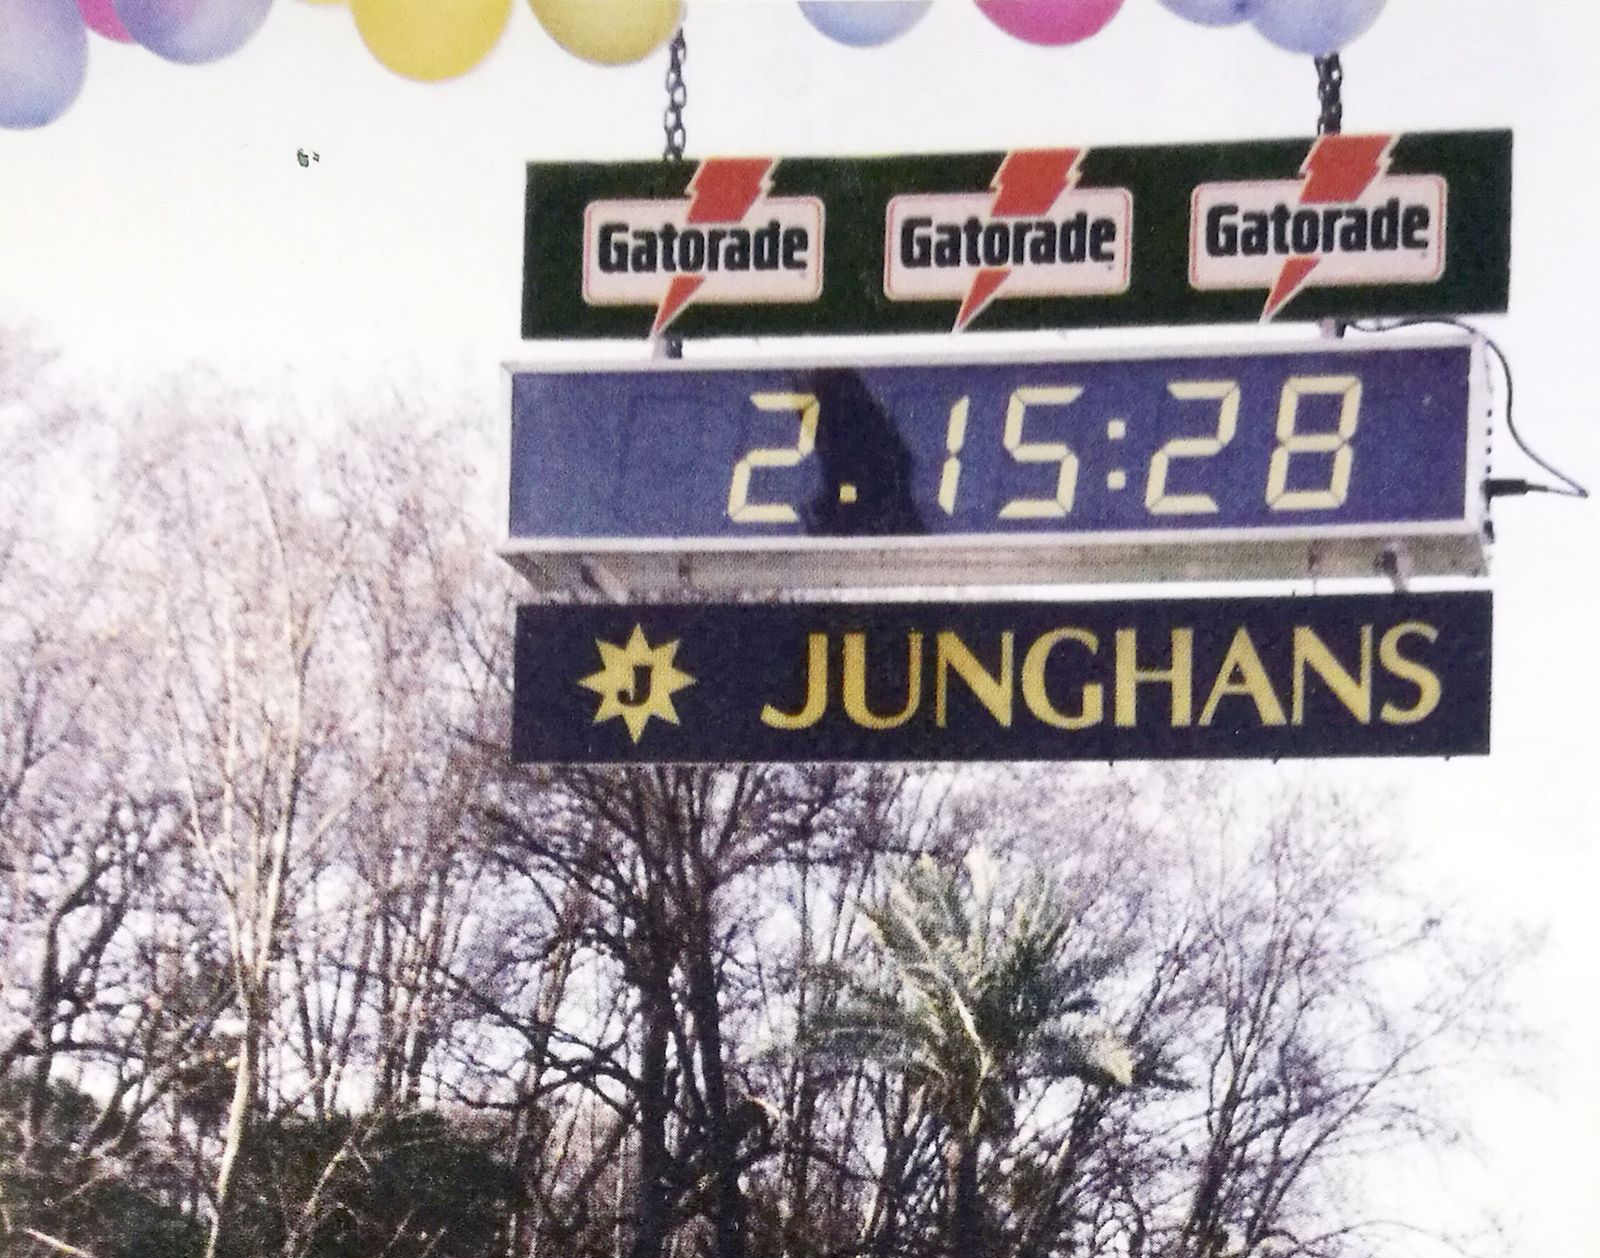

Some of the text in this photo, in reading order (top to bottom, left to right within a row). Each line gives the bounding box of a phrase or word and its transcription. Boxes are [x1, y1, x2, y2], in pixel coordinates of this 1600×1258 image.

[597, 199, 1431, 277] Gatorade Gatorade Gatorade
[760, 622, 1442, 731] JUNGHANS
